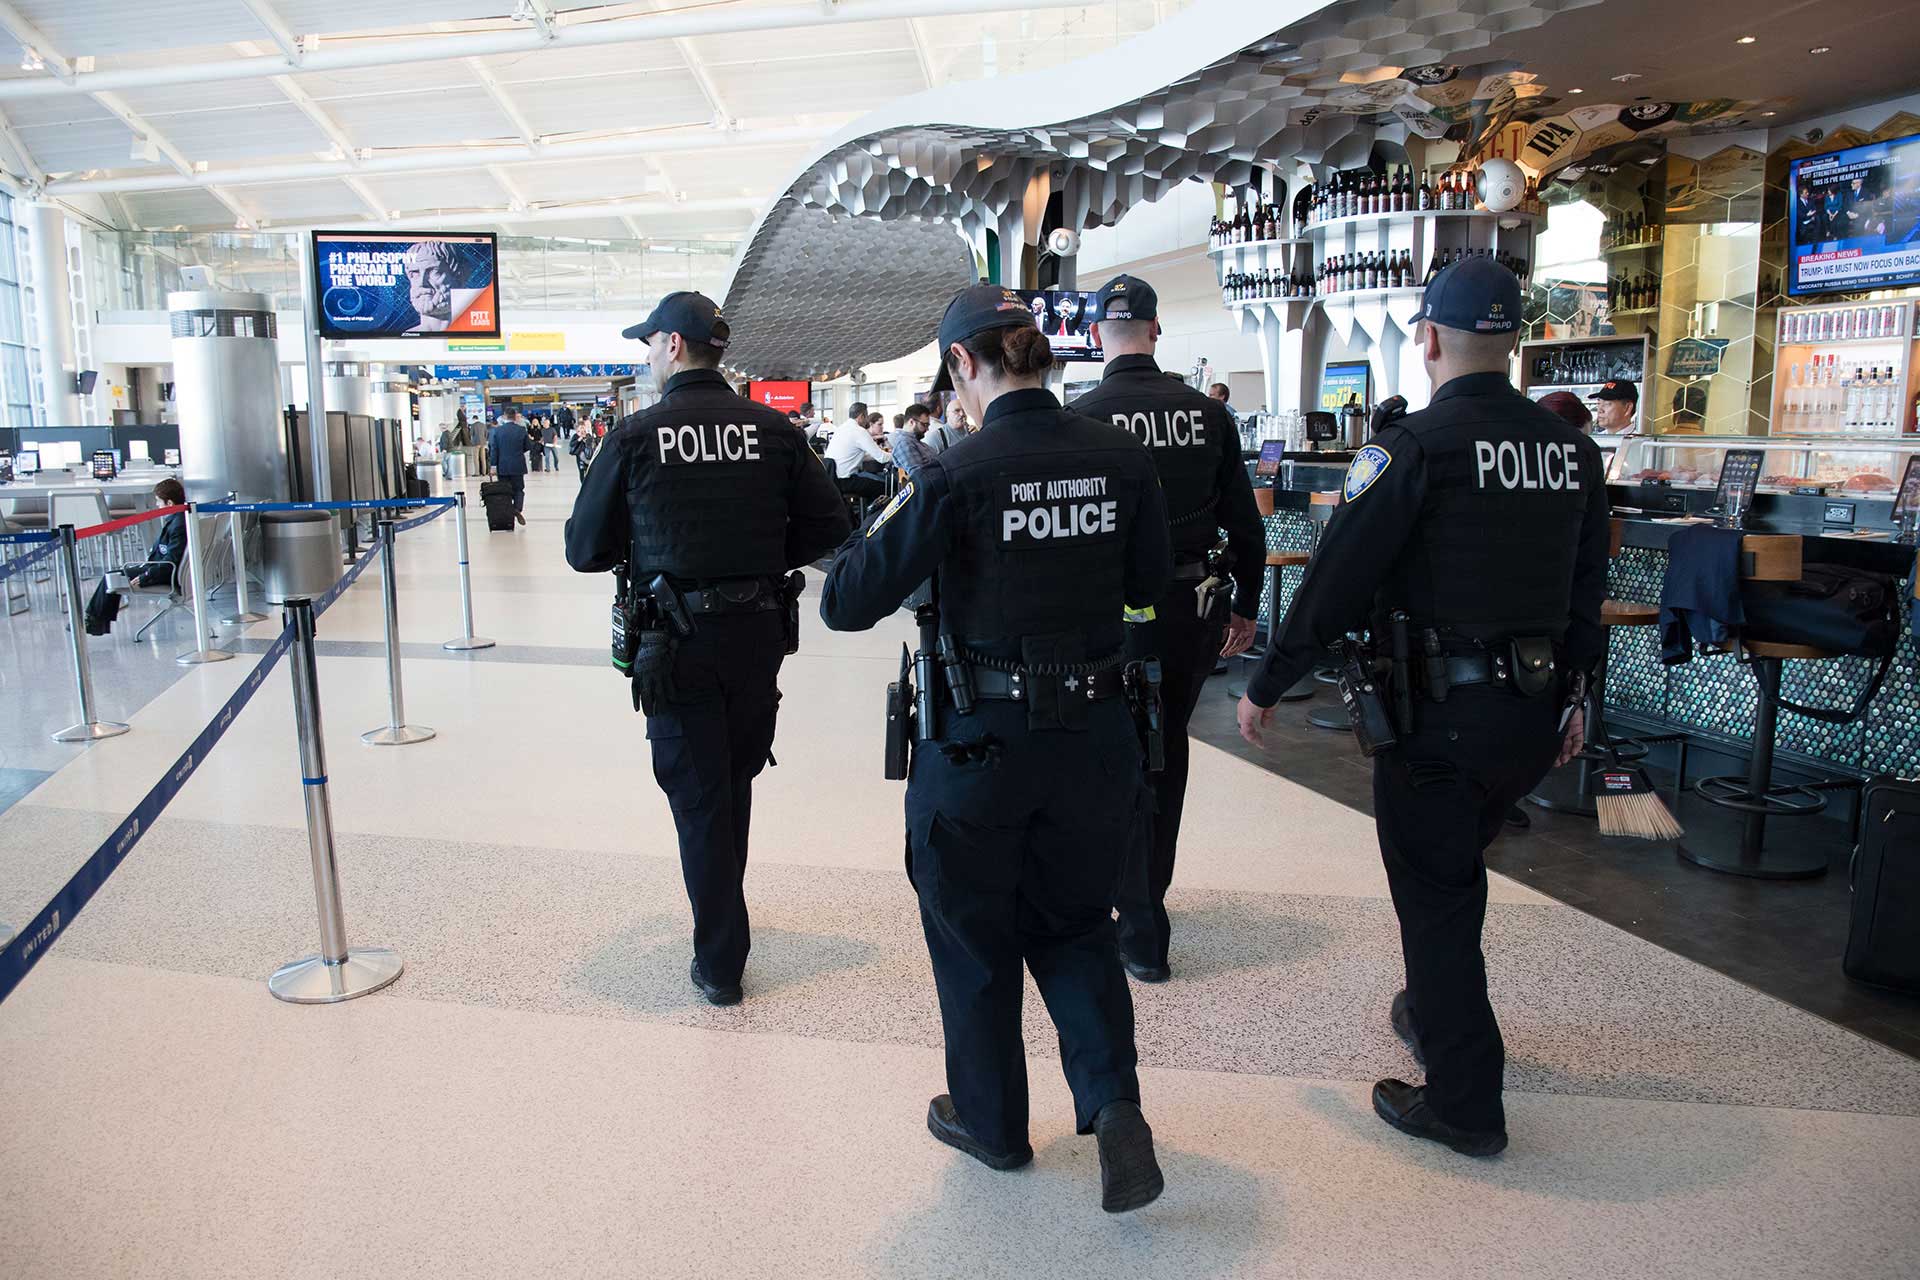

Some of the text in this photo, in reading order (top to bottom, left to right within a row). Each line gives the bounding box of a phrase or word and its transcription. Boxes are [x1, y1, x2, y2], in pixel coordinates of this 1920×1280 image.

[1526, 122, 1574, 158] IPA
[329, 252, 417, 264] #1 PHILOSOPHY
[1801, 249, 1858, 263] BREAKING NEWS
[1801, 266, 1824, 277] TRUMP:
[1824, 265, 1834, 275] WE
[1835, 263, 1853, 274] MUST
[1853, 261, 1870, 272] NOW
[1870, 258, 1892, 270] FOCUS
[1893, 256, 1904, 266] ON
[330, 263, 404, 275] PROGRAM IN
[330, 275, 397, 286] THE WORLD
[1491, 303, 1503, 313] 37
[1490, 320, 1512, 329] PAPD
[657, 424, 760, 464] POLICE
[1475, 440, 1581, 491] POLICE
[1010, 477, 1108, 502] PORT AUTHORITY
[1002, 501, 1118, 542] POLICE
[23, 923, 53, 960] UNITED
